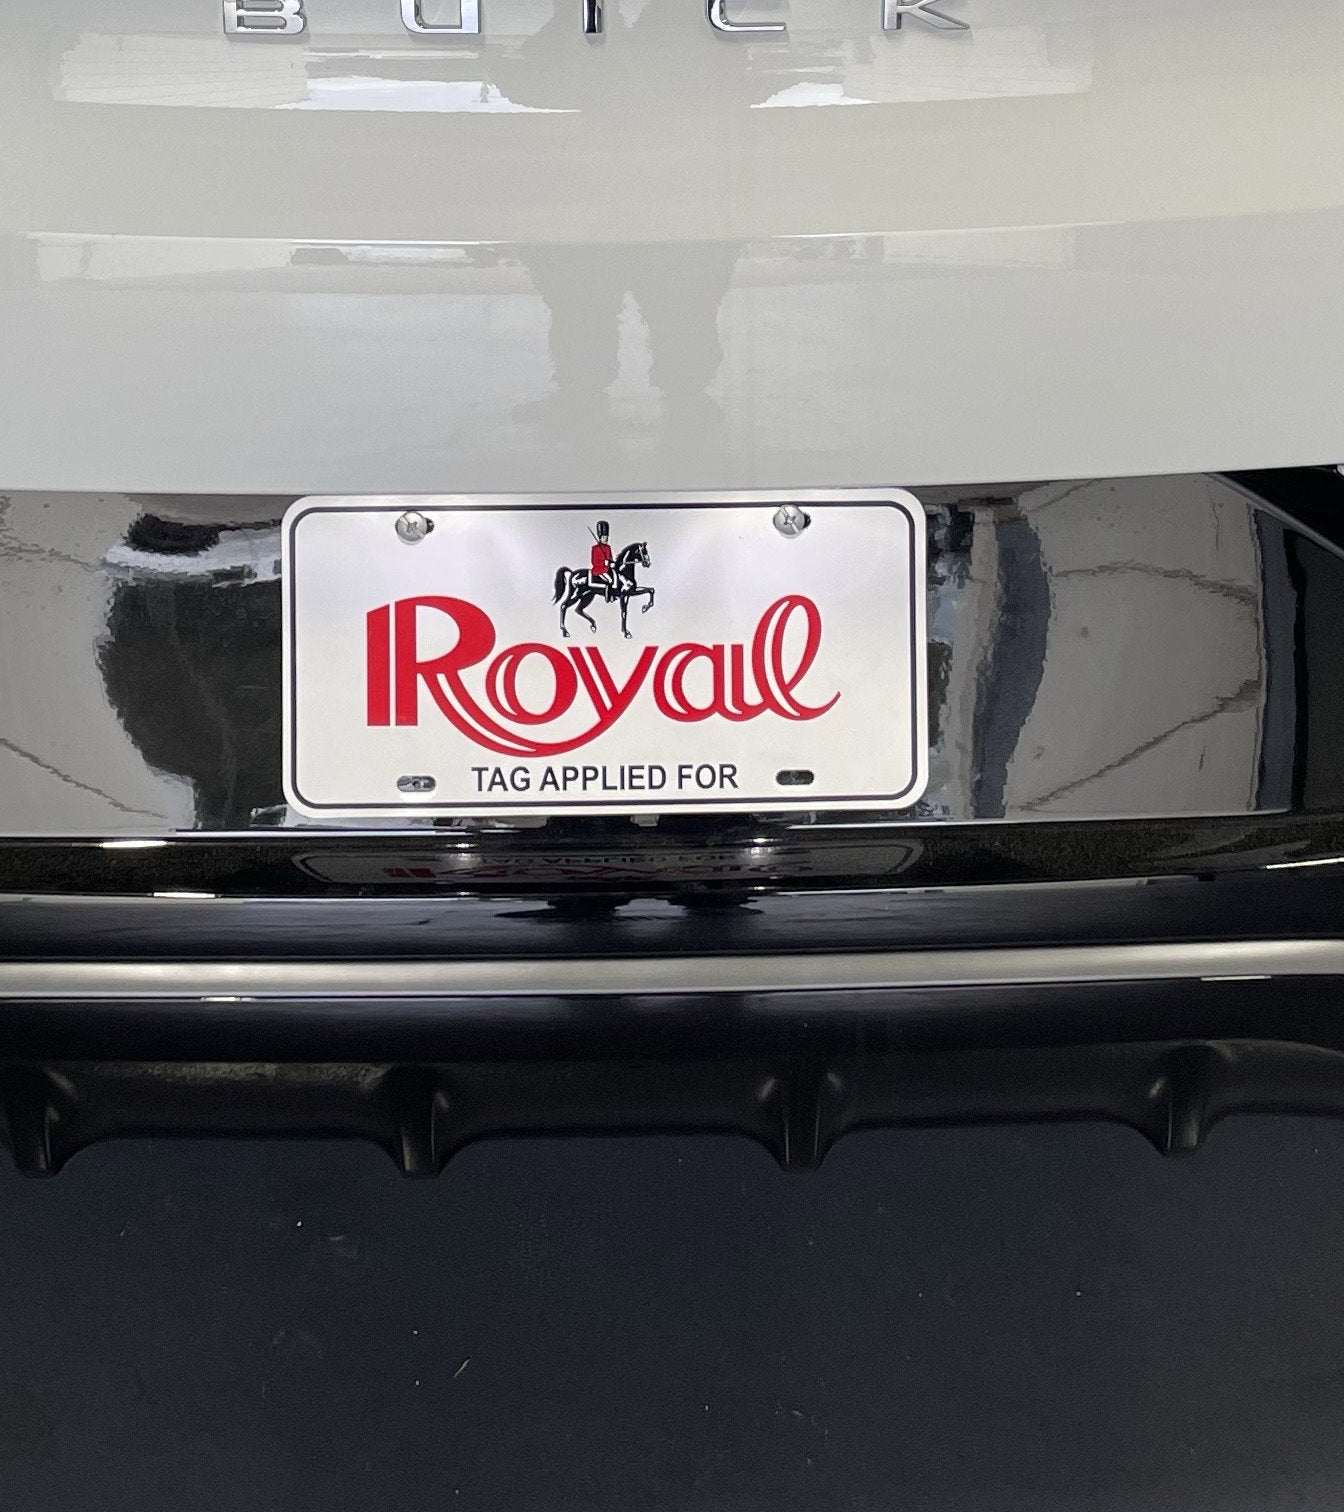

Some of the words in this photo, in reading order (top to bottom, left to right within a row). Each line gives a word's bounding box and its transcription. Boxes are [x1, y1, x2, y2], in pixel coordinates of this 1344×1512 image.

[366, 594, 842, 758] Royal
[471, 766, 531, 793] TAG
[540, 765, 668, 792] APPLIED
[678, 764, 739, 790] FOR
